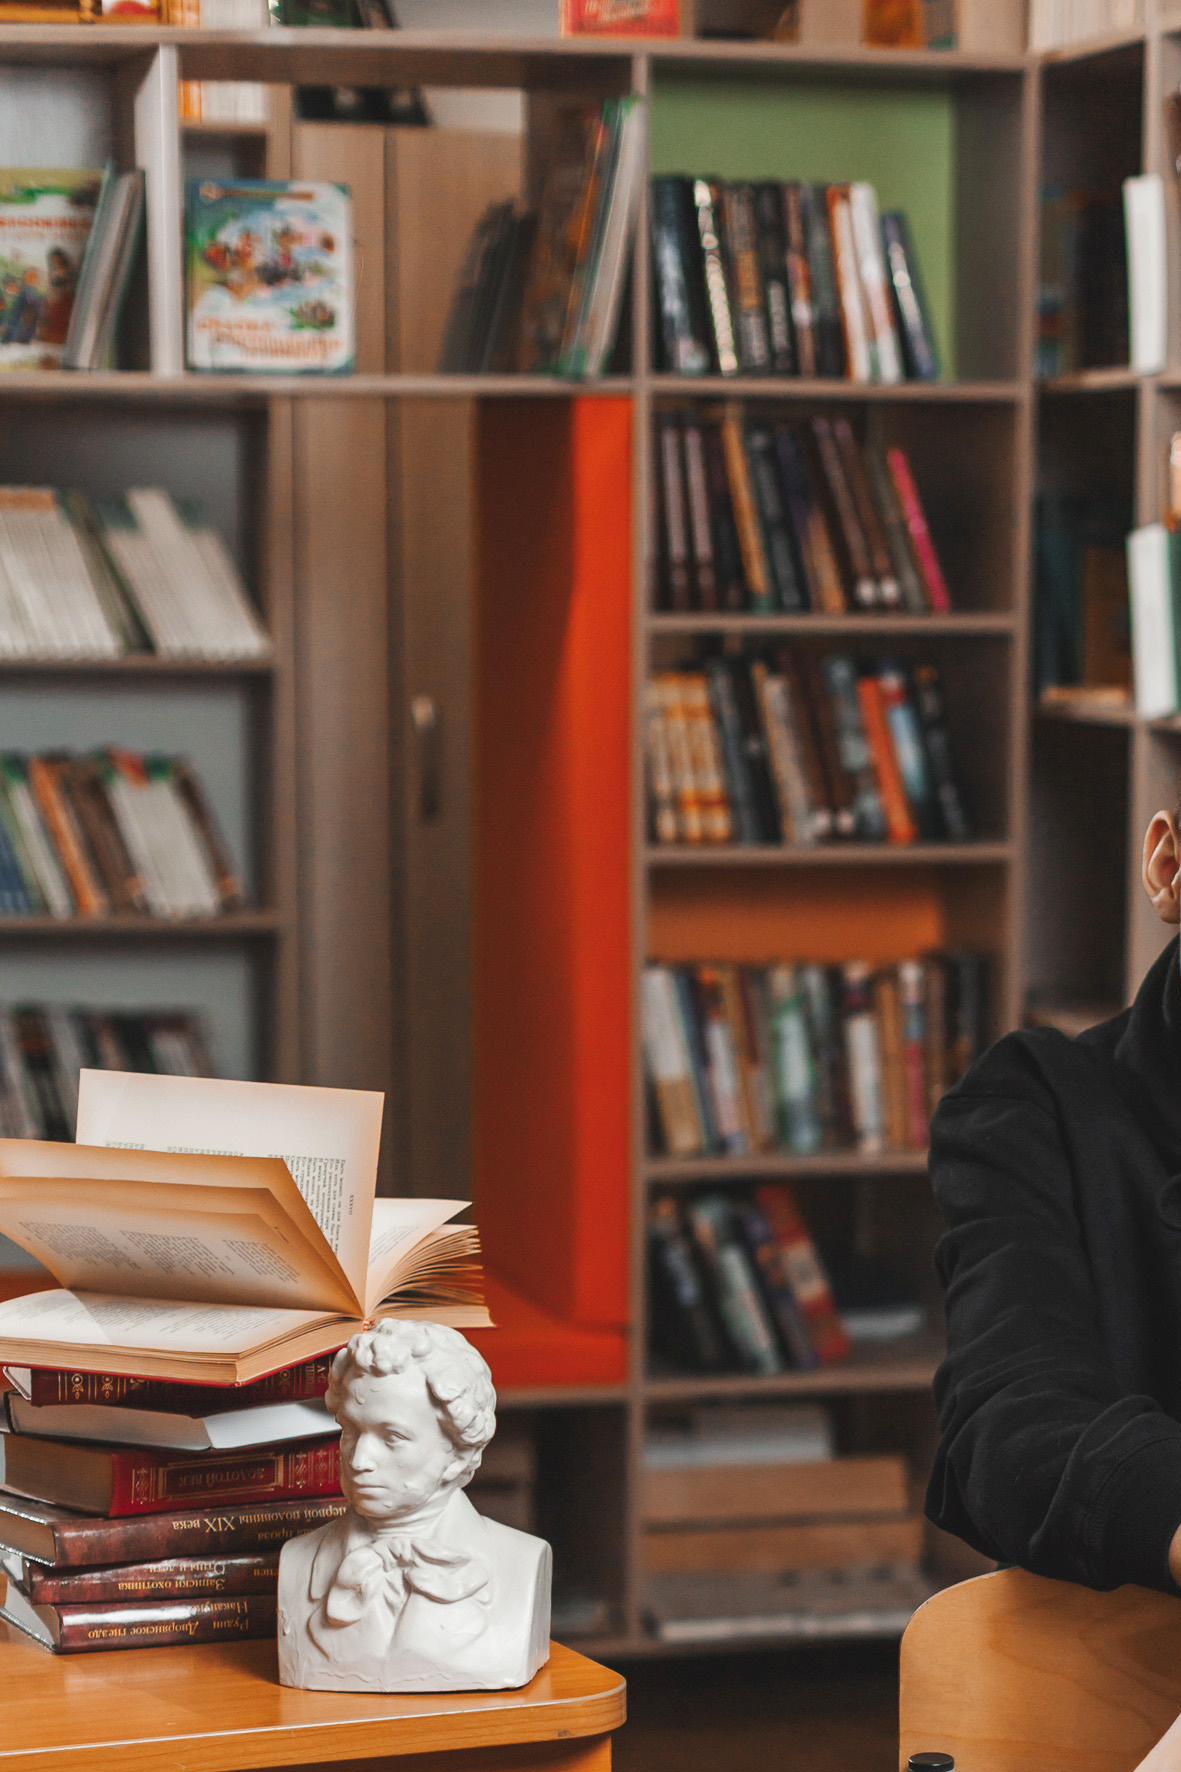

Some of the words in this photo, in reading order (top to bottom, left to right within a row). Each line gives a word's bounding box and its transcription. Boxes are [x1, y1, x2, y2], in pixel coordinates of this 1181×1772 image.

[204, 1516, 236, 1533] XIX
[239, 1510, 300, 1527] половины
[172, 1520, 200, 1532] века
[117, 1580, 172, 1592] охотника
[175, 1578, 226, 1592] Записки
[130, 1620, 199, 1638] Дворянское
[212, 1617, 249, 1632] Рудин
[88, 1626, 127, 1640] гнездо
